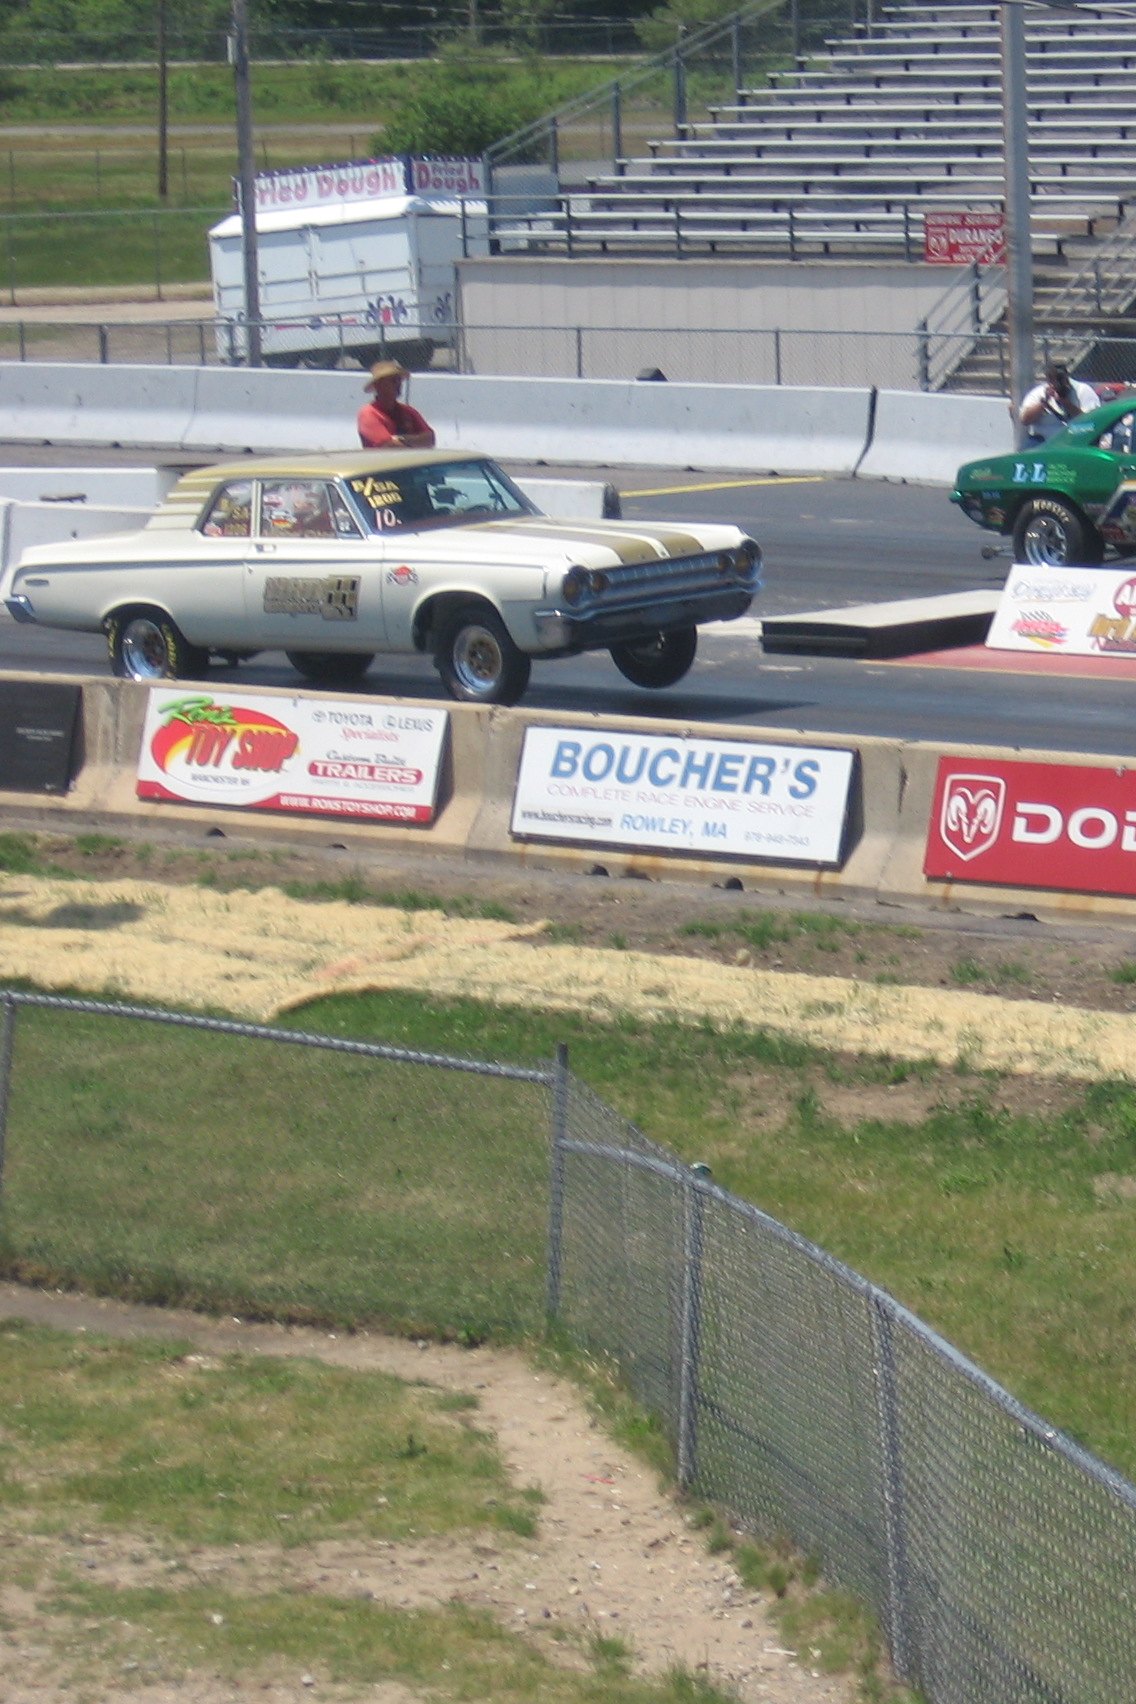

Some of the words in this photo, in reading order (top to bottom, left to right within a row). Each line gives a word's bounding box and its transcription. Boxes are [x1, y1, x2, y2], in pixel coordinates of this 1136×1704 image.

[256, 177, 308, 205] ried
[317, 166, 397, 196] Dough
[415, 163, 480, 193] Dough
[328, 711, 373, 727] TOYOTA
[398, 717, 434, 732] LEXUS
[313, 761, 418, 785] TRAILERS
[549, 740, 821, 800] BOUCHER'S
[547, 783, 632, 801] COMPLETE
[635, 790, 680, 807] RACE
[684, 795, 742, 812] ENGINE
[746, 801, 816, 818] SERVICE
[620, 813, 694, 838] ROWLEY,
[701, 820, 728, 839] MA
